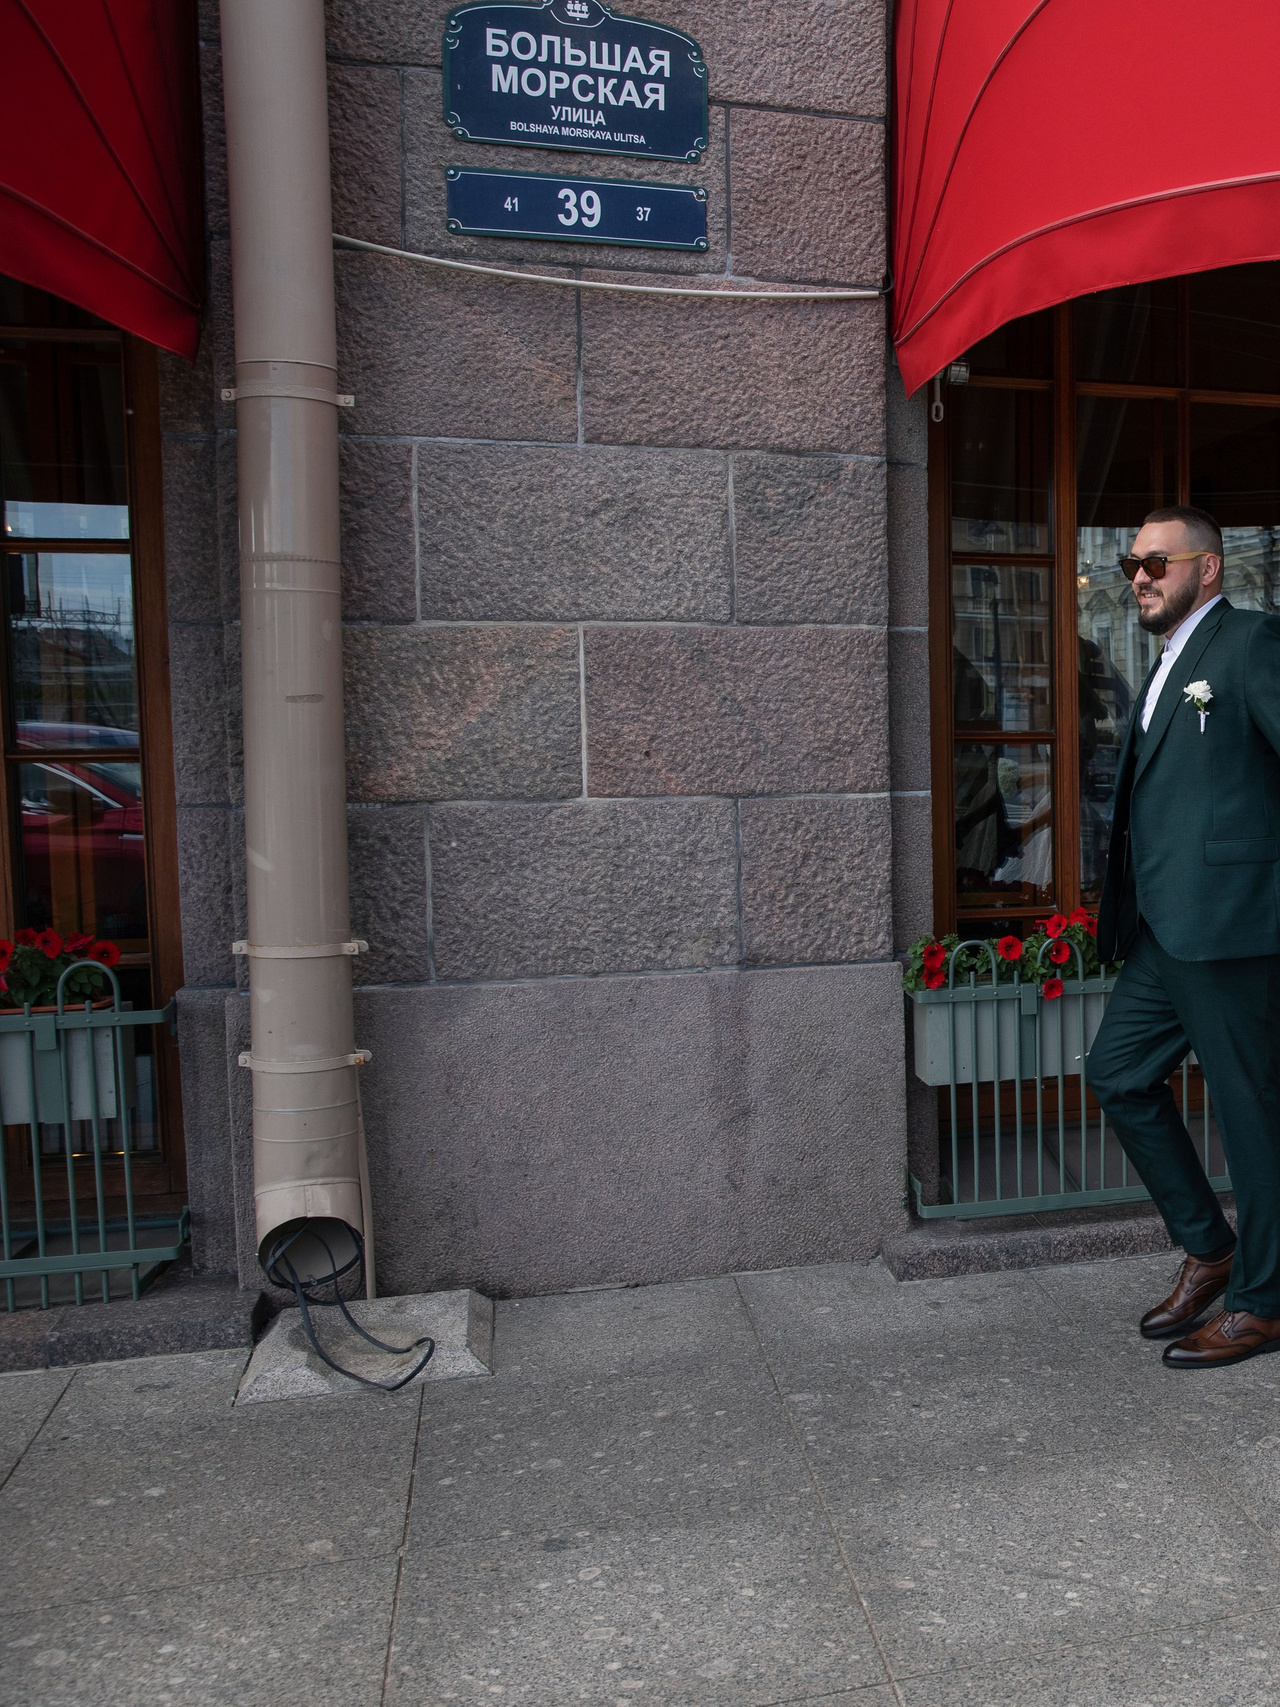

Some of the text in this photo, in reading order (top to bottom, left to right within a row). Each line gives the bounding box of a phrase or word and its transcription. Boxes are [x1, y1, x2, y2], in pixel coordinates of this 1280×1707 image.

[486, 27, 671, 78] БОЛЬШАЯ
[491, 63, 665, 111] МОРСКАЯ
[510, 121, 646, 144] BOLSHAYA MORSKAYA ULITSA
[550, 105, 606, 127] УЛИЦА
[504, 188, 651, 228] 41 39 37
